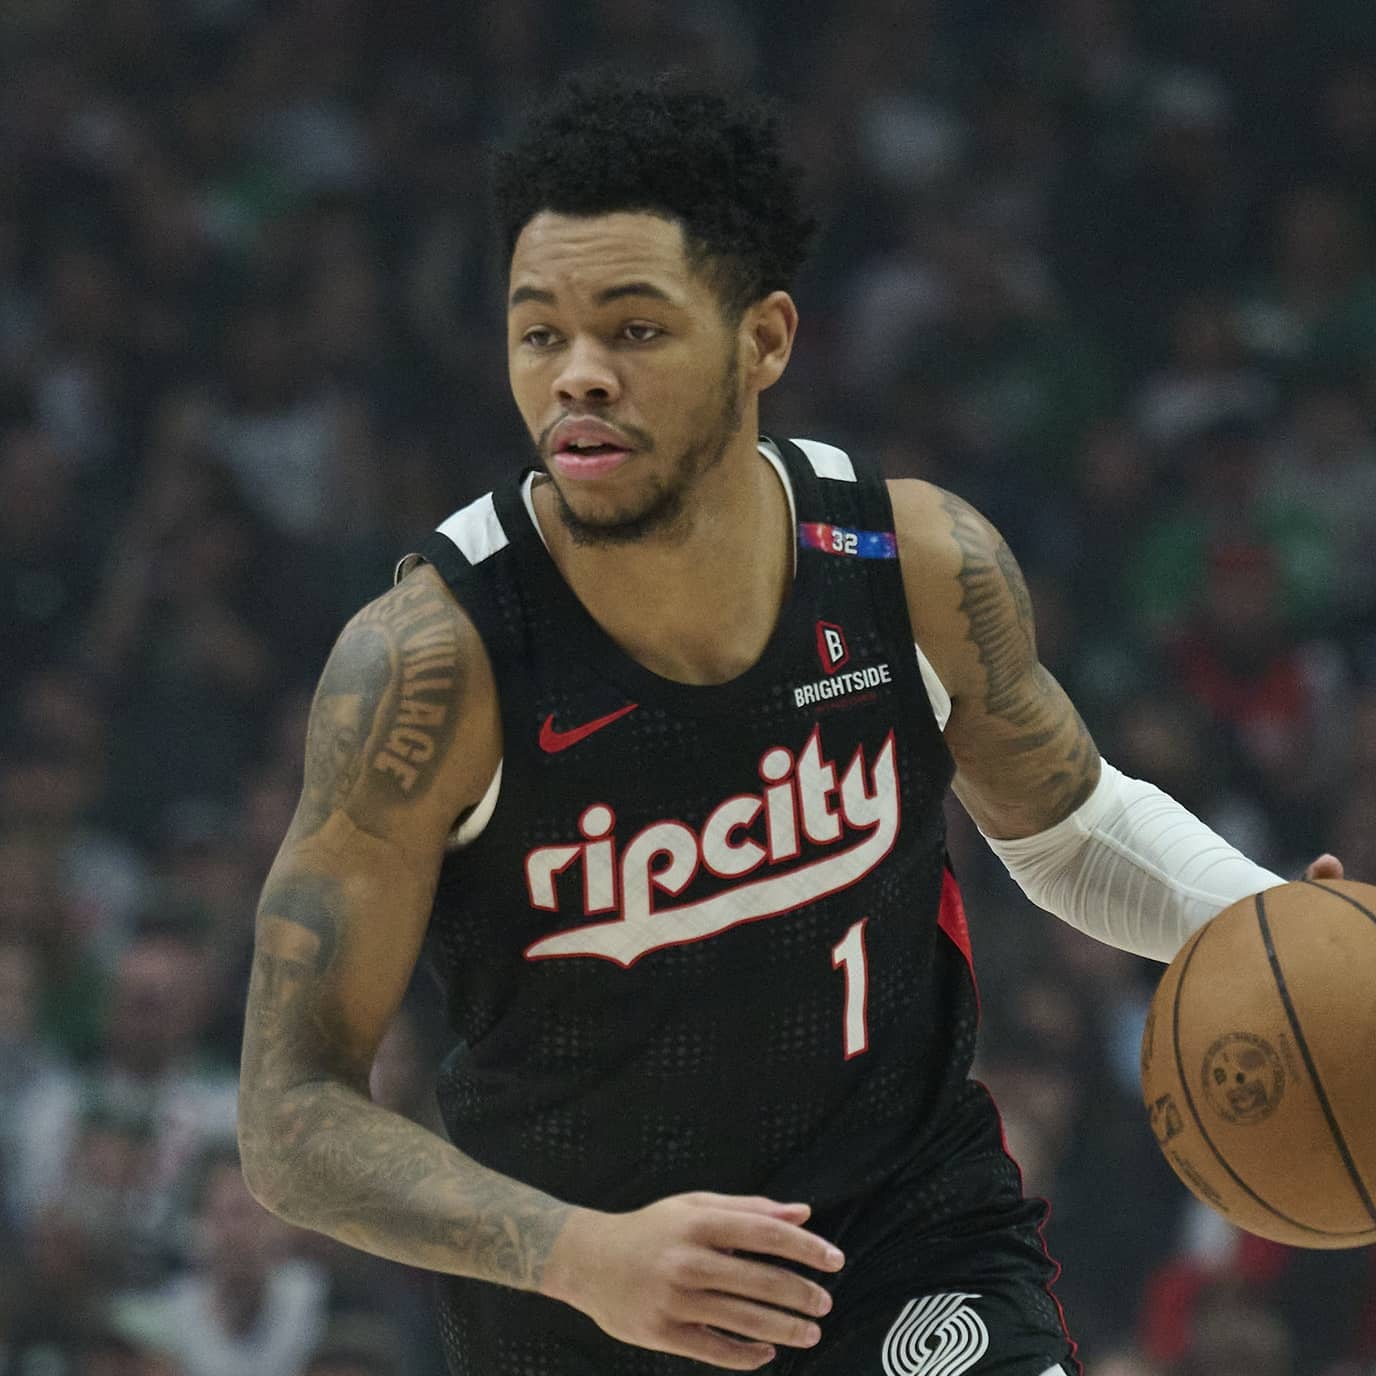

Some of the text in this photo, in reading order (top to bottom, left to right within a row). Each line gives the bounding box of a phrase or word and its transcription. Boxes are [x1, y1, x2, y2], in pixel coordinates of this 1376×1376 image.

[831, 530, 859, 555] 32
[824, 628, 845, 664] B
[373, 618, 458, 793] VILLAGE
[793, 663, 893, 709] BRIGHTSIDE
[831, 916, 869, 1061] 1
